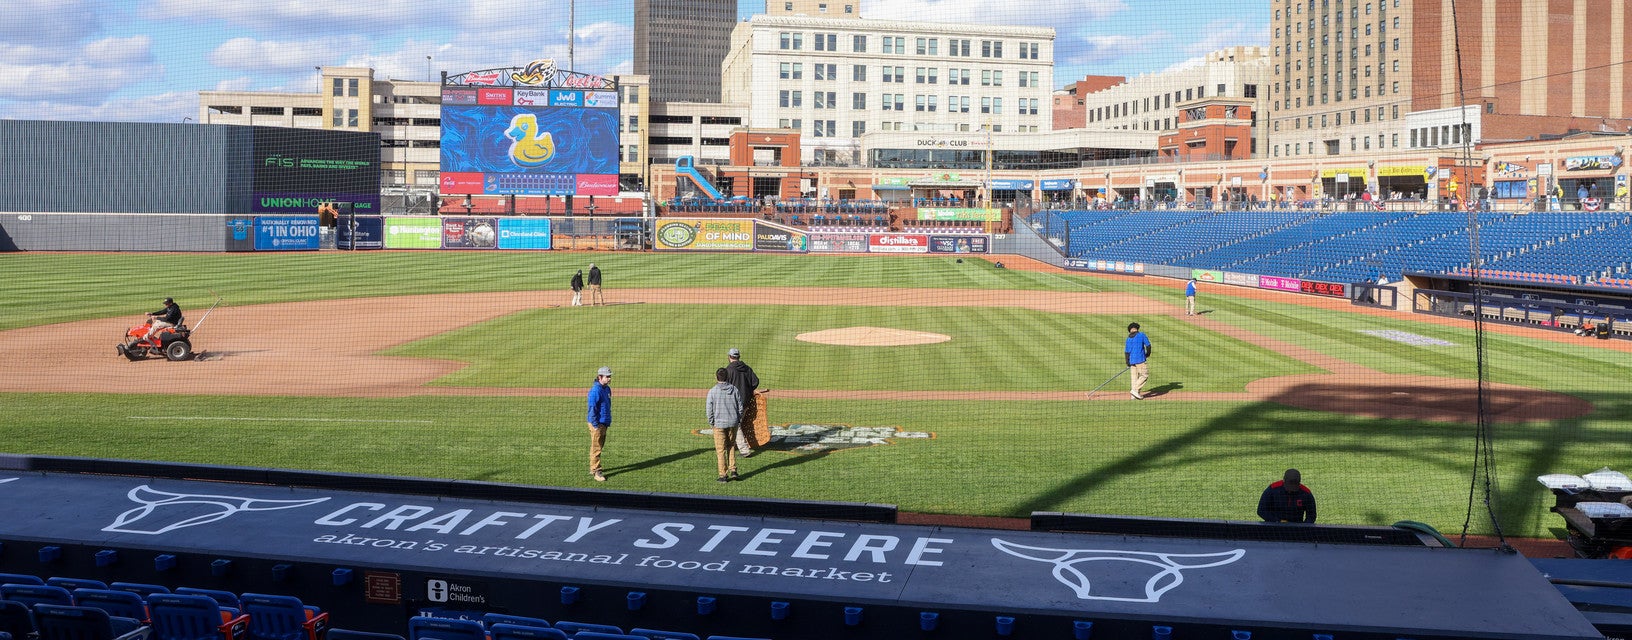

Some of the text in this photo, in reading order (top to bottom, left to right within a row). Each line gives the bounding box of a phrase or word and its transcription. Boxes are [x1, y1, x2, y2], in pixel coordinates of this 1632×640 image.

[579, 181, 616, 189] Budweiser
[262, 226, 317, 237] #1 IN OHIO
[400, 225, 440, 235] Huntington
[705, 223, 740, 231] PEACE
[705, 232, 750, 241] OF MIND
[313, 503, 954, 567] CRAFTY STEERE
[313, 533, 893, 583] akron's artisanal food market
[450, 584, 471, 592] Akron
[450, 592, 485, 603] Children's
